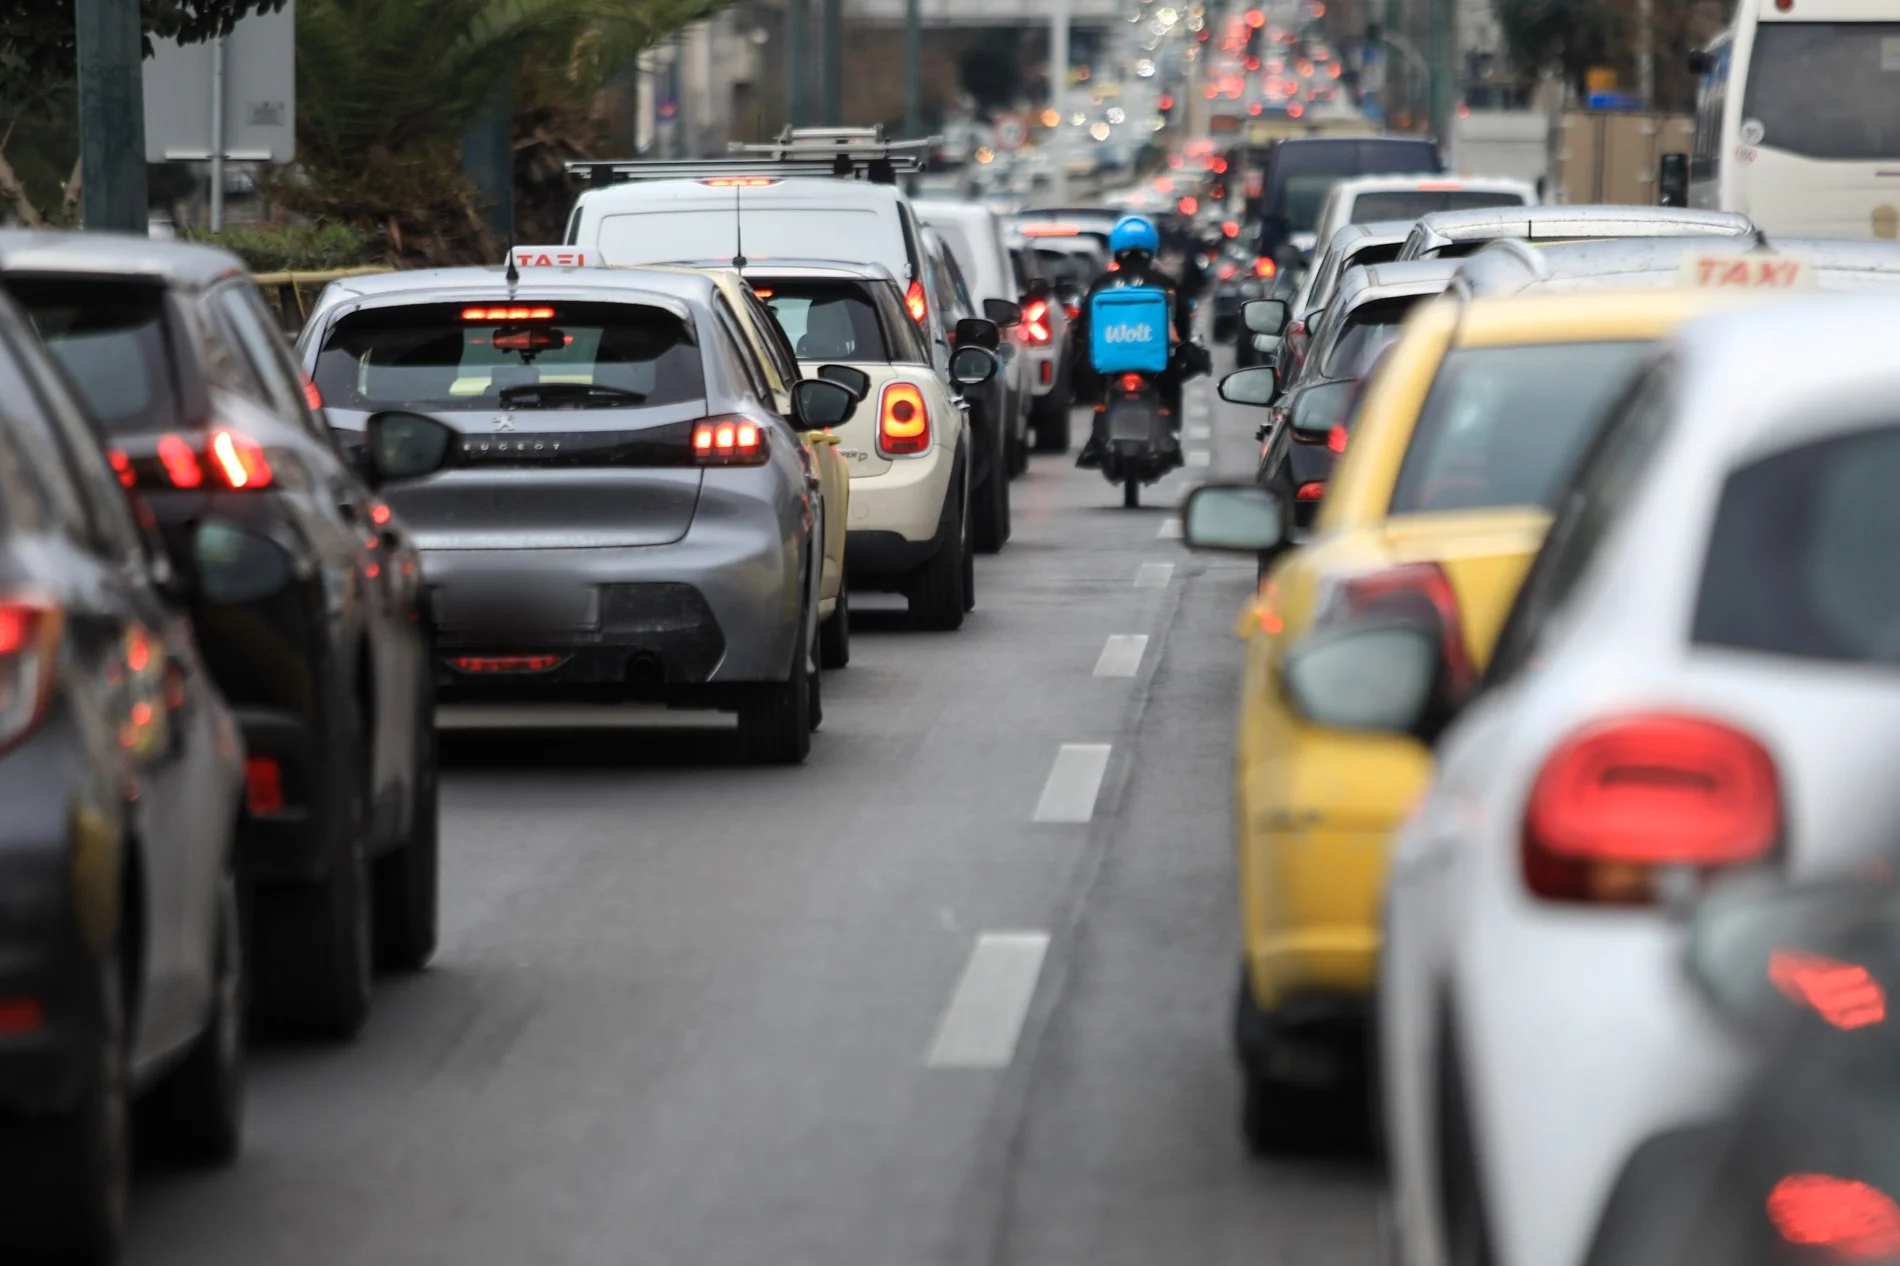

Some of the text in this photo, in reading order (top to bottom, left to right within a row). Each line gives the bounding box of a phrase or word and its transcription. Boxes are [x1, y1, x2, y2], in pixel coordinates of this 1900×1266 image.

[1698, 257, 1800, 286] TAXI
[1105, 323, 1153, 344] Wolt
[463, 442, 560, 451] EUGEOT
